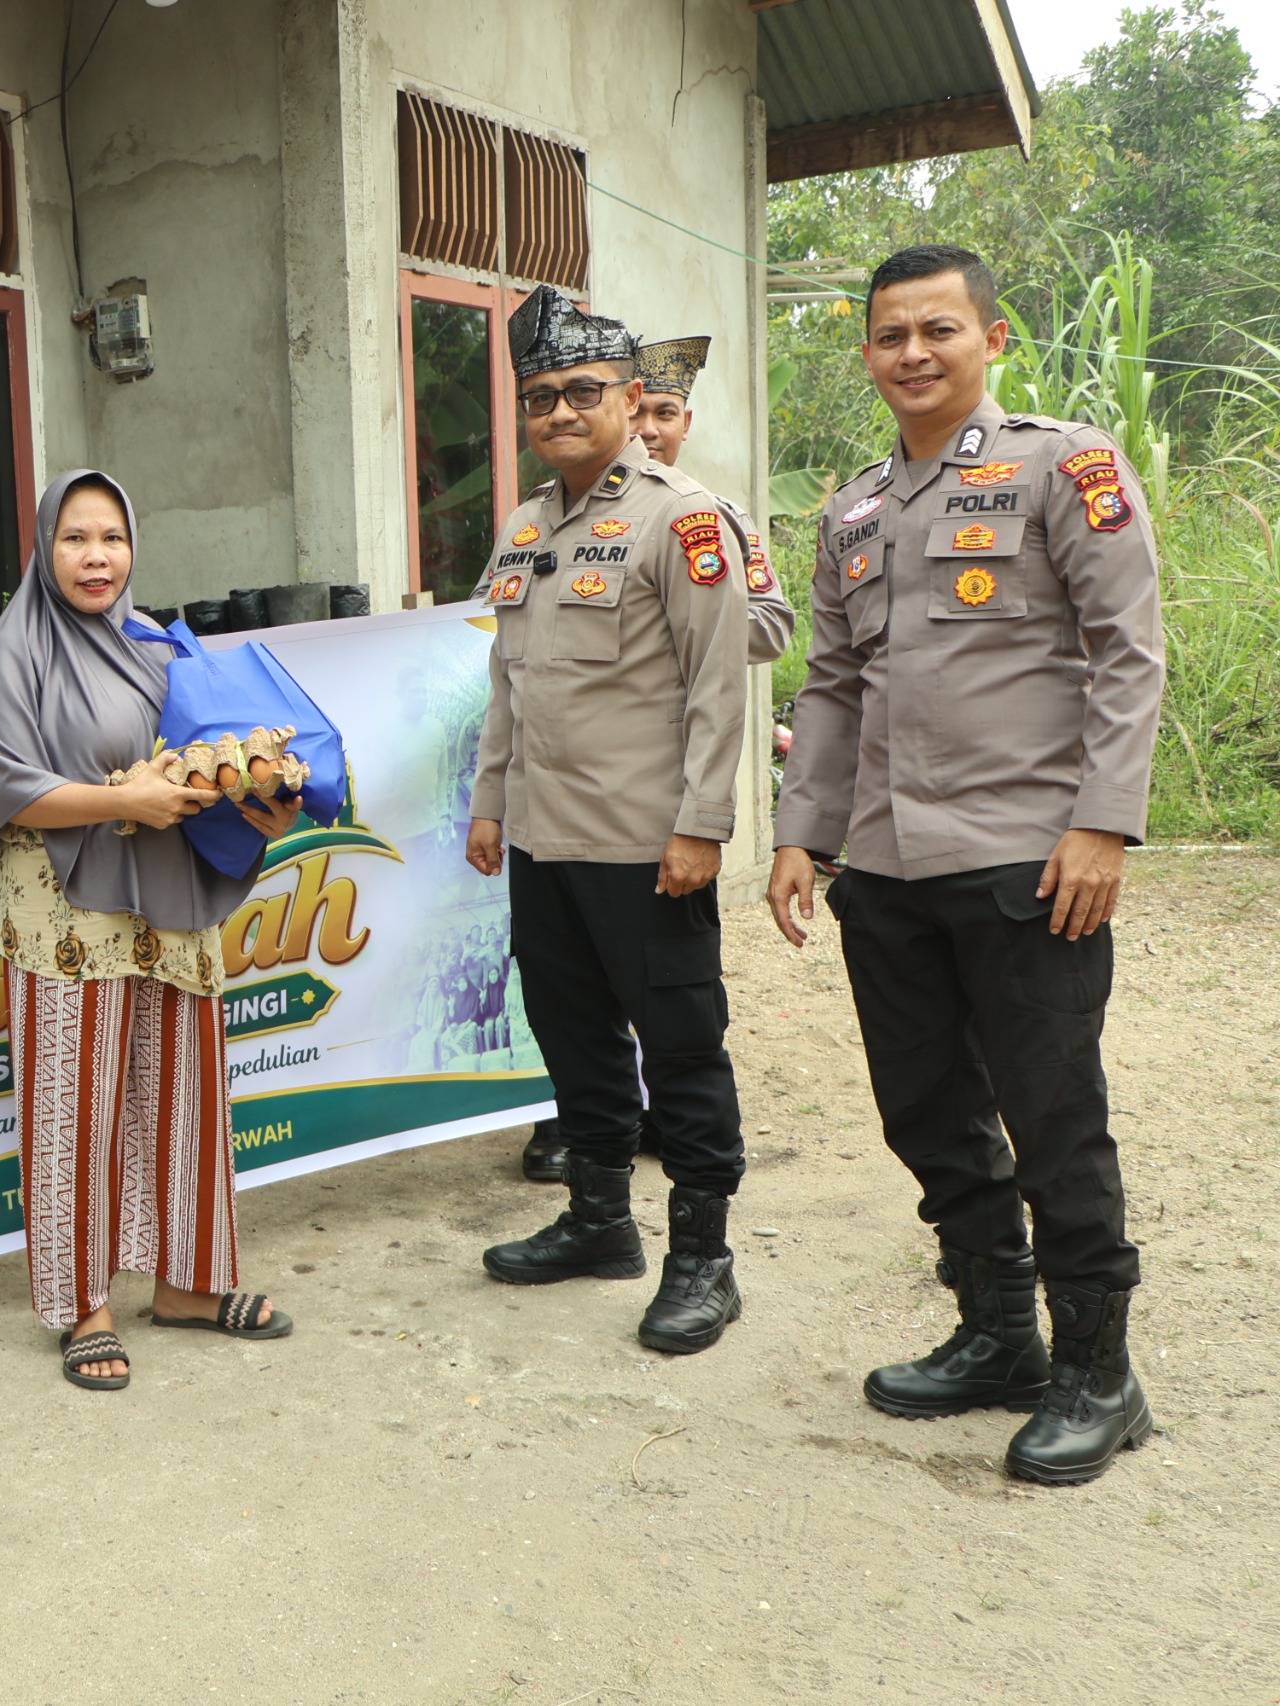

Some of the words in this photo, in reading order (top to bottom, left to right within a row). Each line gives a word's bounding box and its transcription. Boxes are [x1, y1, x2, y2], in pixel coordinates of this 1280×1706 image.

[1065, 450, 1111, 469] POLRES
[1081, 470, 1115, 486] RIAU
[945, 492, 1018, 513] POLRI
[676, 513, 716, 530] POLRES
[686, 531, 714, 543] RIAU
[838, 518, 880, 553] S.GANDI
[497, 550, 538, 570] KENNY
[573, 545, 628, 562] POLRI
[228, 1043, 322, 1090] pedulian
[231, 1119, 293, 1151] RWAH
